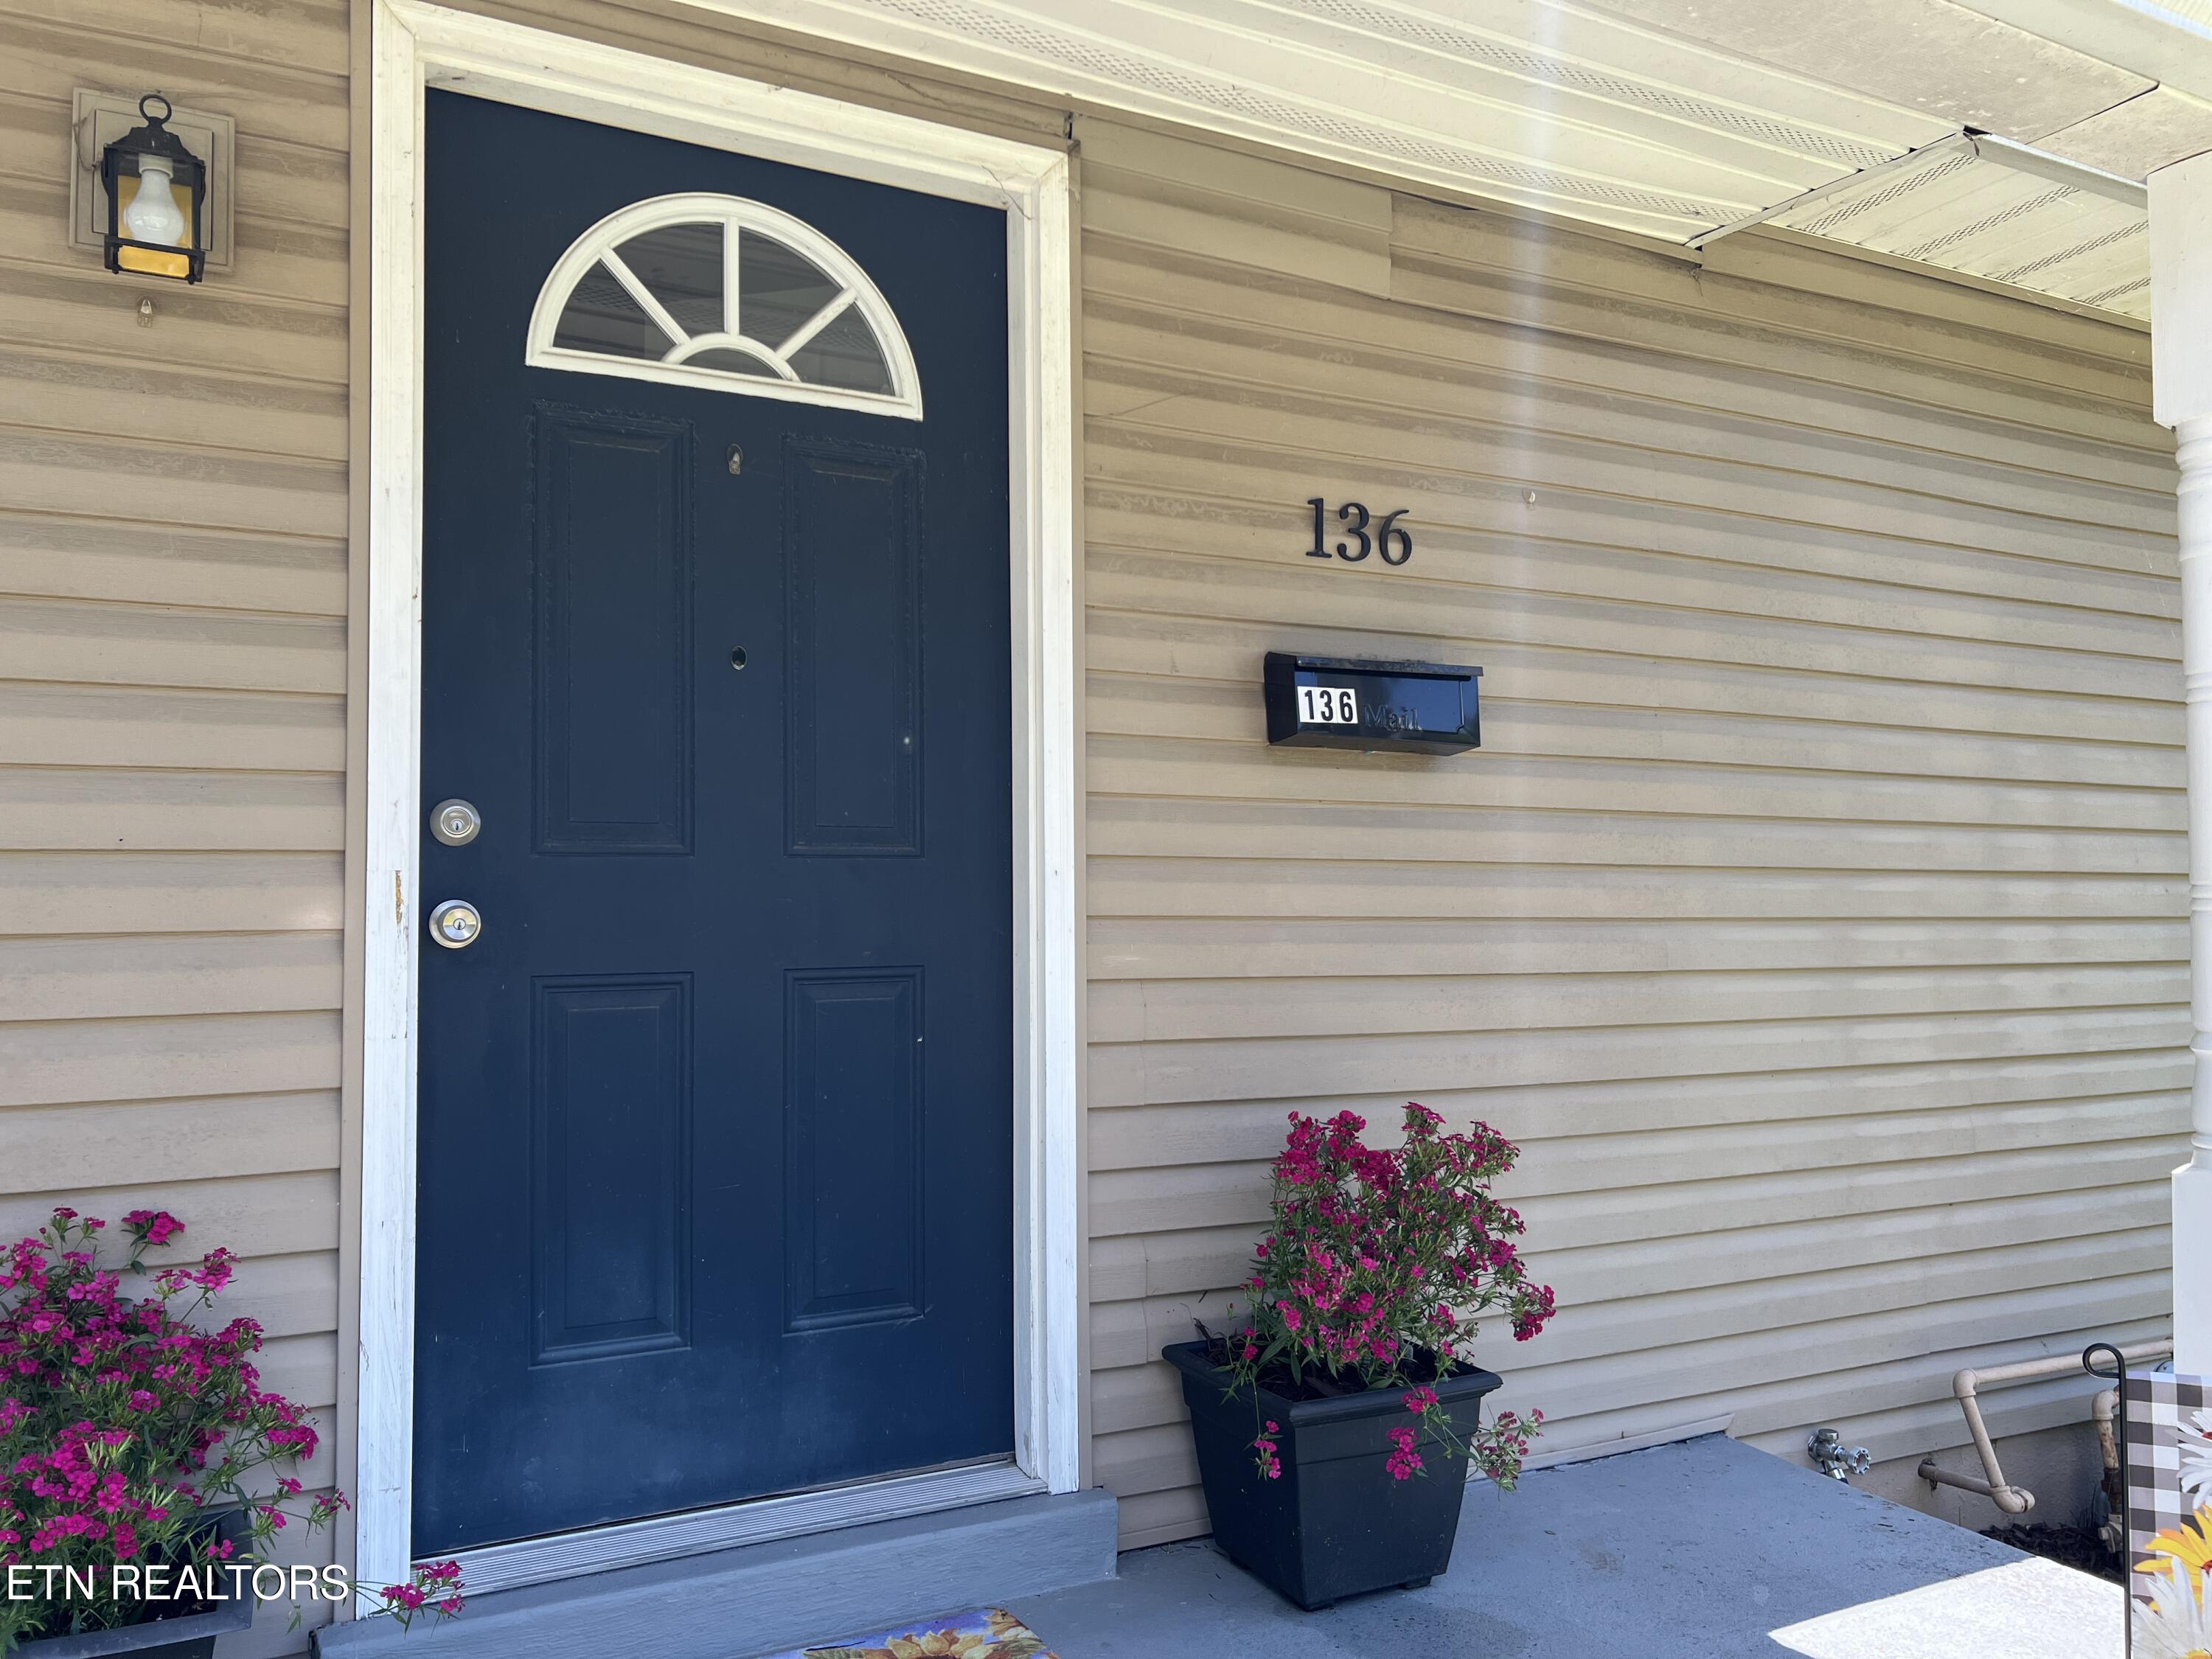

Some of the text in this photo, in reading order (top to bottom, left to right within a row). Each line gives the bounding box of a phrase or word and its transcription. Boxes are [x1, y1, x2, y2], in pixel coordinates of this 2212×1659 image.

[1305, 498, 1413, 566] 136
[1304, 689, 1354, 723] 136
[1363, 703, 1422, 732] Mail
